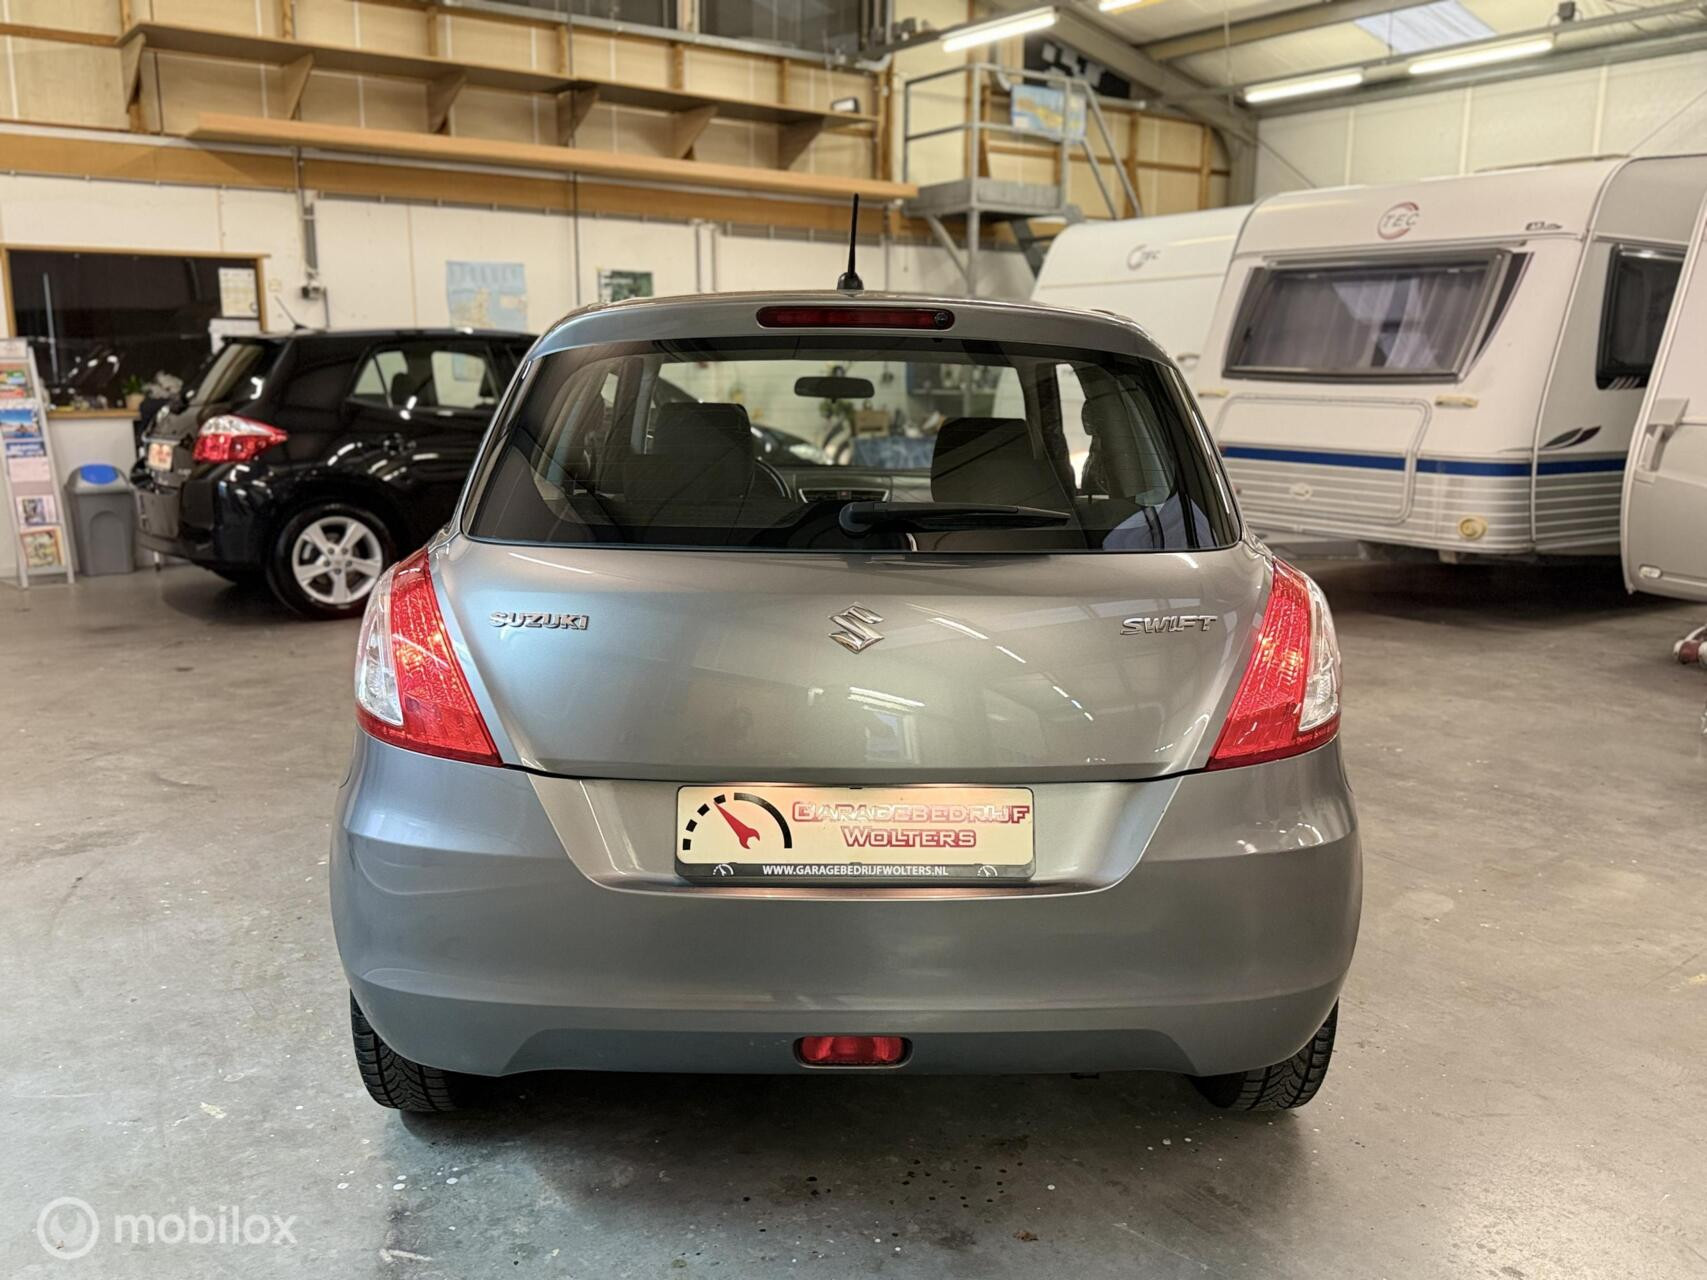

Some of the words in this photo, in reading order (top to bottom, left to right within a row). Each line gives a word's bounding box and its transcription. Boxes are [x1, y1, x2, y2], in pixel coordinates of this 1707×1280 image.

[1382, 212, 1420, 228] TEC
[490, 611, 590, 631] SUZUKI
[1120, 615, 1218, 636] SWIFT
[792, 801, 1030, 824] GARAGEBEDRIJF
[841, 825, 977, 848] WOLTERS
[762, 864, 949, 876] WWW.GARAGEBEDRIJFWOLTERS.NL
